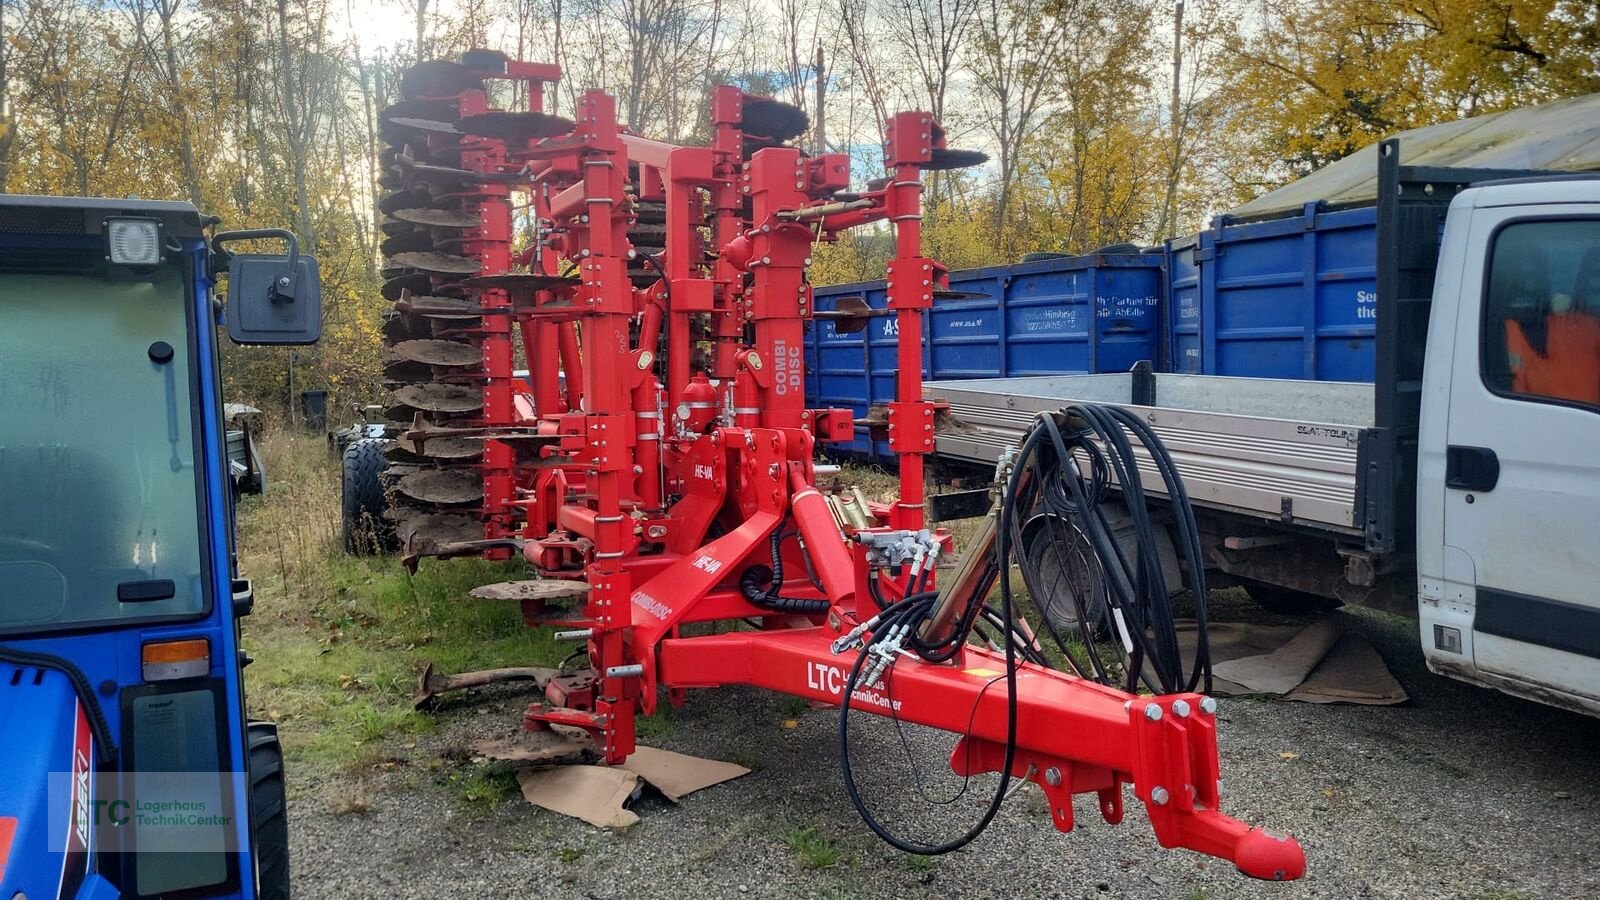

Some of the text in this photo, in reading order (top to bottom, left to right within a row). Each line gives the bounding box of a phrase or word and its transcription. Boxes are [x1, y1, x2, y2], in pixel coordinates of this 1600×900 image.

[774, 340, 787, 395] COMBI
[695, 464, 713, 481] HE-VA
[692, 554, 722, 575] HE-VA
[808, 661, 841, 694] LTC
[843, 685, 902, 711] chnikCener
[76, 749, 88, 849] ISEKI
